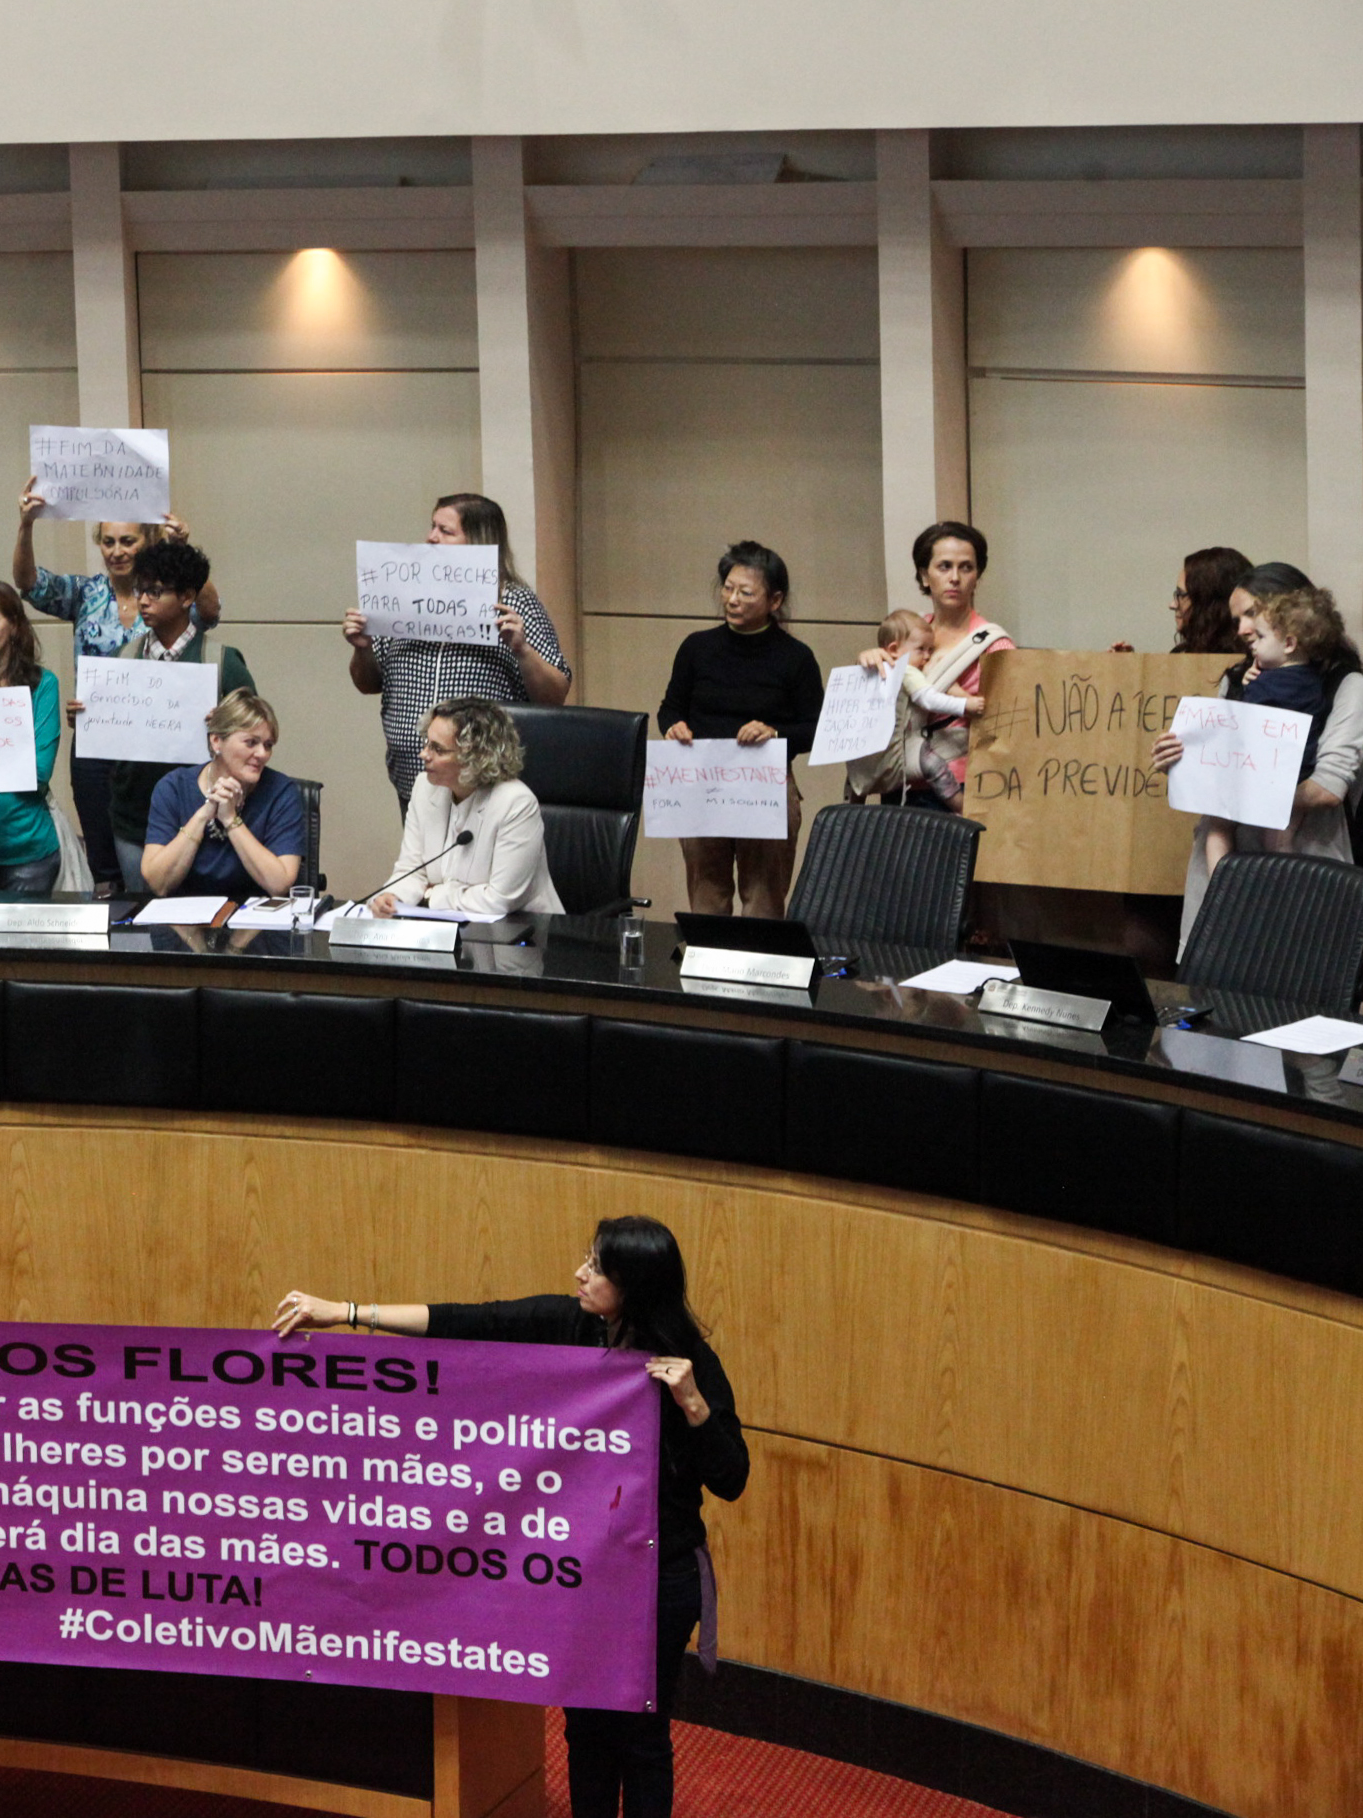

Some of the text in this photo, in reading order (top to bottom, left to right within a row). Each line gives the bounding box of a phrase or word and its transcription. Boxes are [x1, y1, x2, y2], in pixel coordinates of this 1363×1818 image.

[104, 440, 126, 456] DA
[43, 461, 164, 480] MATERNIDADE
[431, 564, 498, 585] CRECHES
[360, 593, 497, 619] PARA TODAS AS
[147, 676, 163, 689] DO
[2, 697, 26, 708] DAS
[167, 699, 181, 709] DA
[1107, 691, 1126, 731] A
[4, 716, 22, 727] OS
[145, 715, 182, 731] NEGRA
[1262, 719, 1298, 740] EM
[972, 766, 1023, 801] DA
[1022, 1003, 1055, 1019] Kennedy
[1056, 1009, 1081, 1020] Nunes
[123, 1345, 440, 1396] FLORES!
[18, 1396, 64, 1422] as
[76, 1391, 242, 1433] funções
[254, 1403, 401, 1439] sociais
[414, 1416, 439, 1441] e
[453, 1414, 632, 1455] políticas
[141, 1445, 210, 1476] por
[221, 1449, 348, 1480] serem
[363, 1453, 484, 1496] mães,
[498, 1467, 522, 1492] e
[536, 1470, 563, 1495] o
[162, 1490, 309, 1522] nossas
[321, 1493, 432, 1531] vidas
[445, 1509, 469, 1534] e
[483, 1511, 507, 1536] a
[520, 1506, 571, 1542] de
[60, 1521, 120, 1555] dia
[133, 1525, 206, 1560] das
[220, 1532, 340, 1569] mães.
[354, 1539, 508, 1581] TODOS
[522, 1552, 583, 1589] OS
[70, 1565, 127, 1598] DE
[141, 1569, 262, 1607] LUTA!
[59, 1607, 550, 1678] #ColetivoMãenifestates
